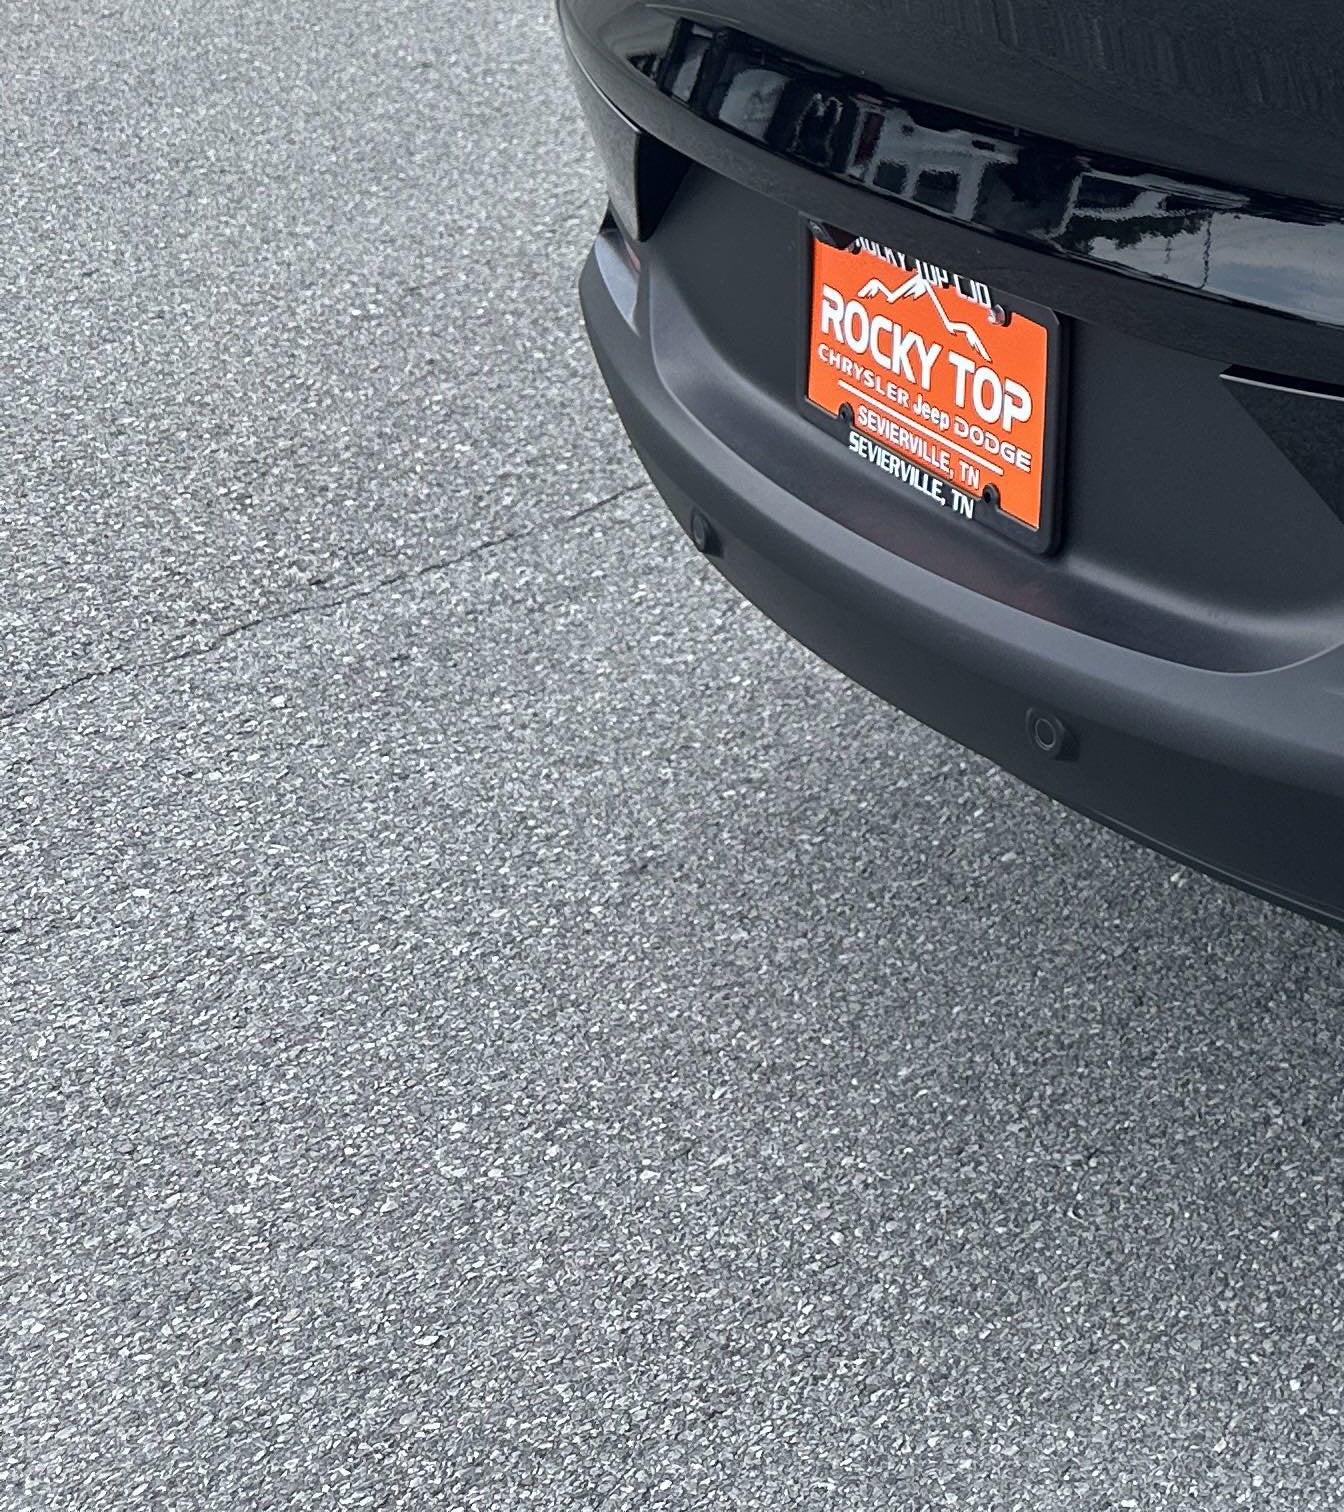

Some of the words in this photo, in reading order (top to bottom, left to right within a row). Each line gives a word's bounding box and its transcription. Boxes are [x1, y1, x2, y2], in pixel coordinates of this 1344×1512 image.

[817, 343, 910, 409] CHRYSLER
[912, 393, 951, 431] Jeep
[953, 418, 1033, 473] DODGE
[821, 285, 943, 391] ROCKY
[948, 351, 1033, 434] TOP
[848, 430, 948, 508] SEVIERVILLE,
[951, 490, 975, 520] TN
[857, 405, 955, 480] SEVIERVILLE,
[958, 459, 981, 491] TN
